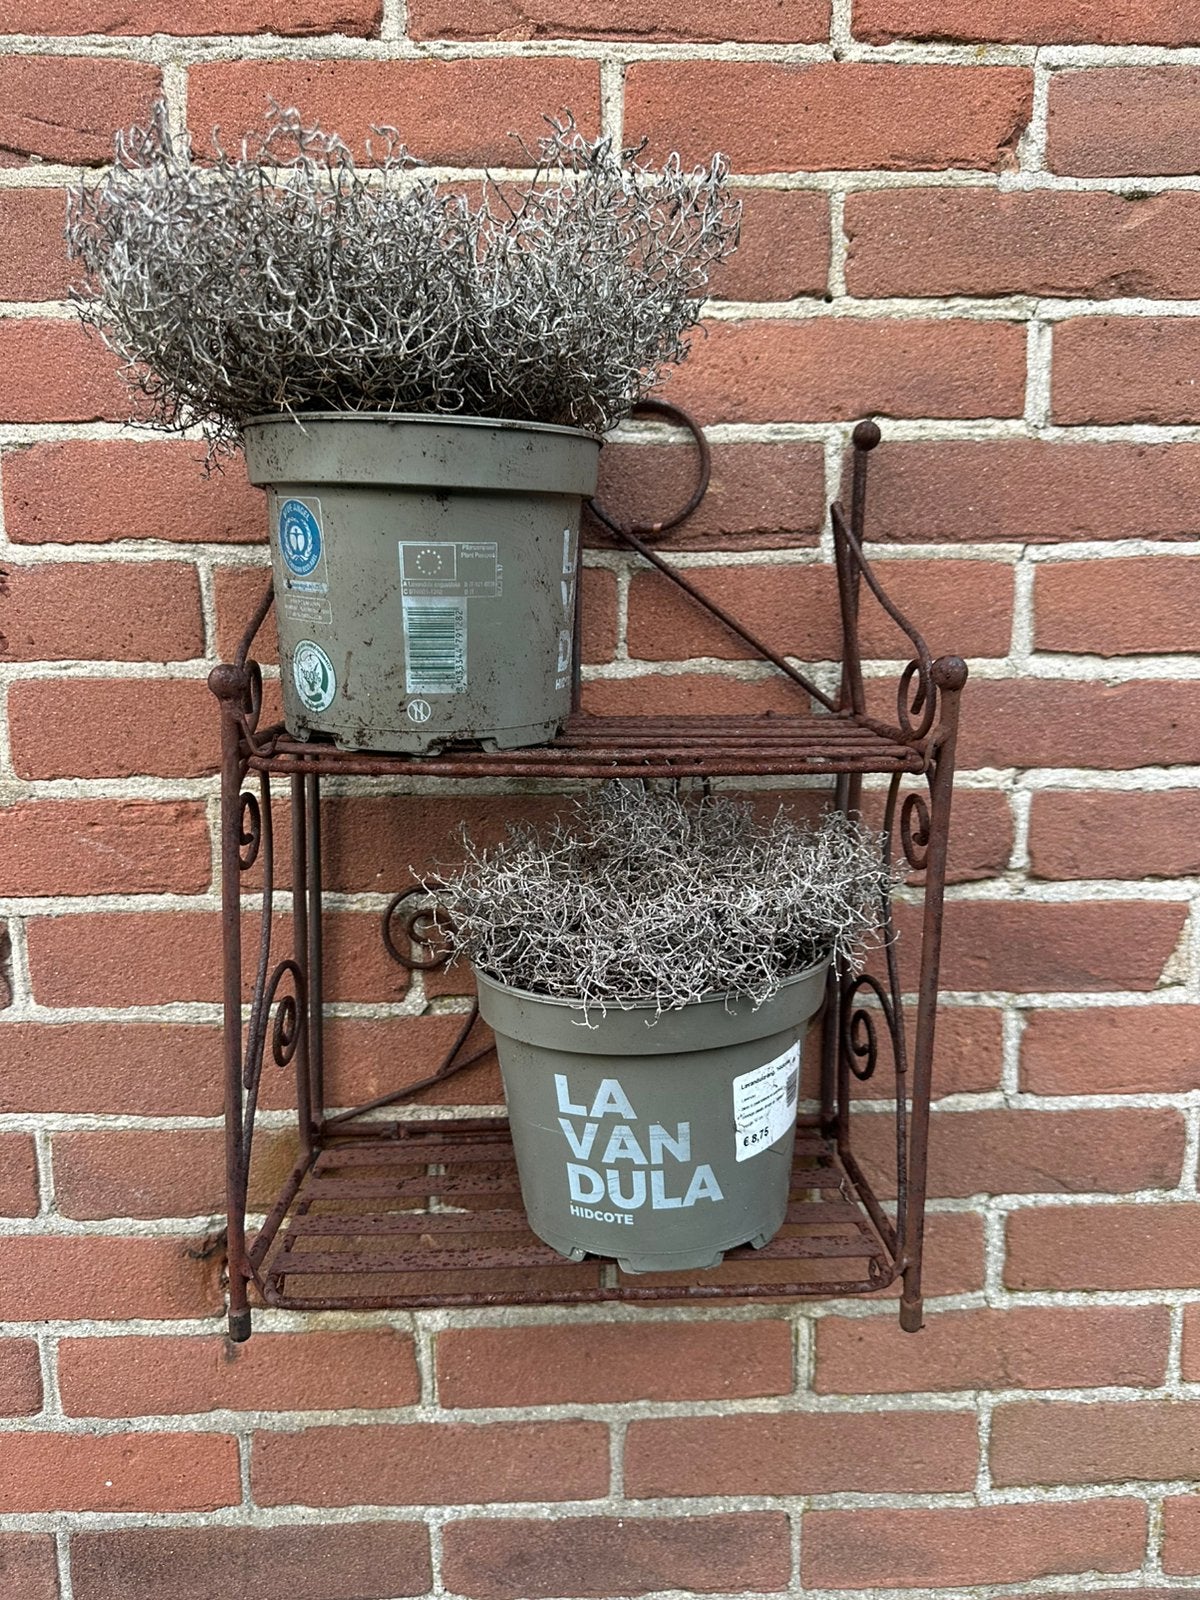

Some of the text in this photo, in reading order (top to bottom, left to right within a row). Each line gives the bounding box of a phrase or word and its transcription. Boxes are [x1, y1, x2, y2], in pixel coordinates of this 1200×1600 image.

[293, 503, 310, 522] ANGEL
[455, 610, 464, 643] 791282
[554, 1073, 638, 1120] LA
[557, 1117, 691, 1165] VAN
[751, 1126, 770, 1145] 8,75
[566, 1162, 724, 1210] DULA
[570, 1204, 634, 1226] HIDCOTE
